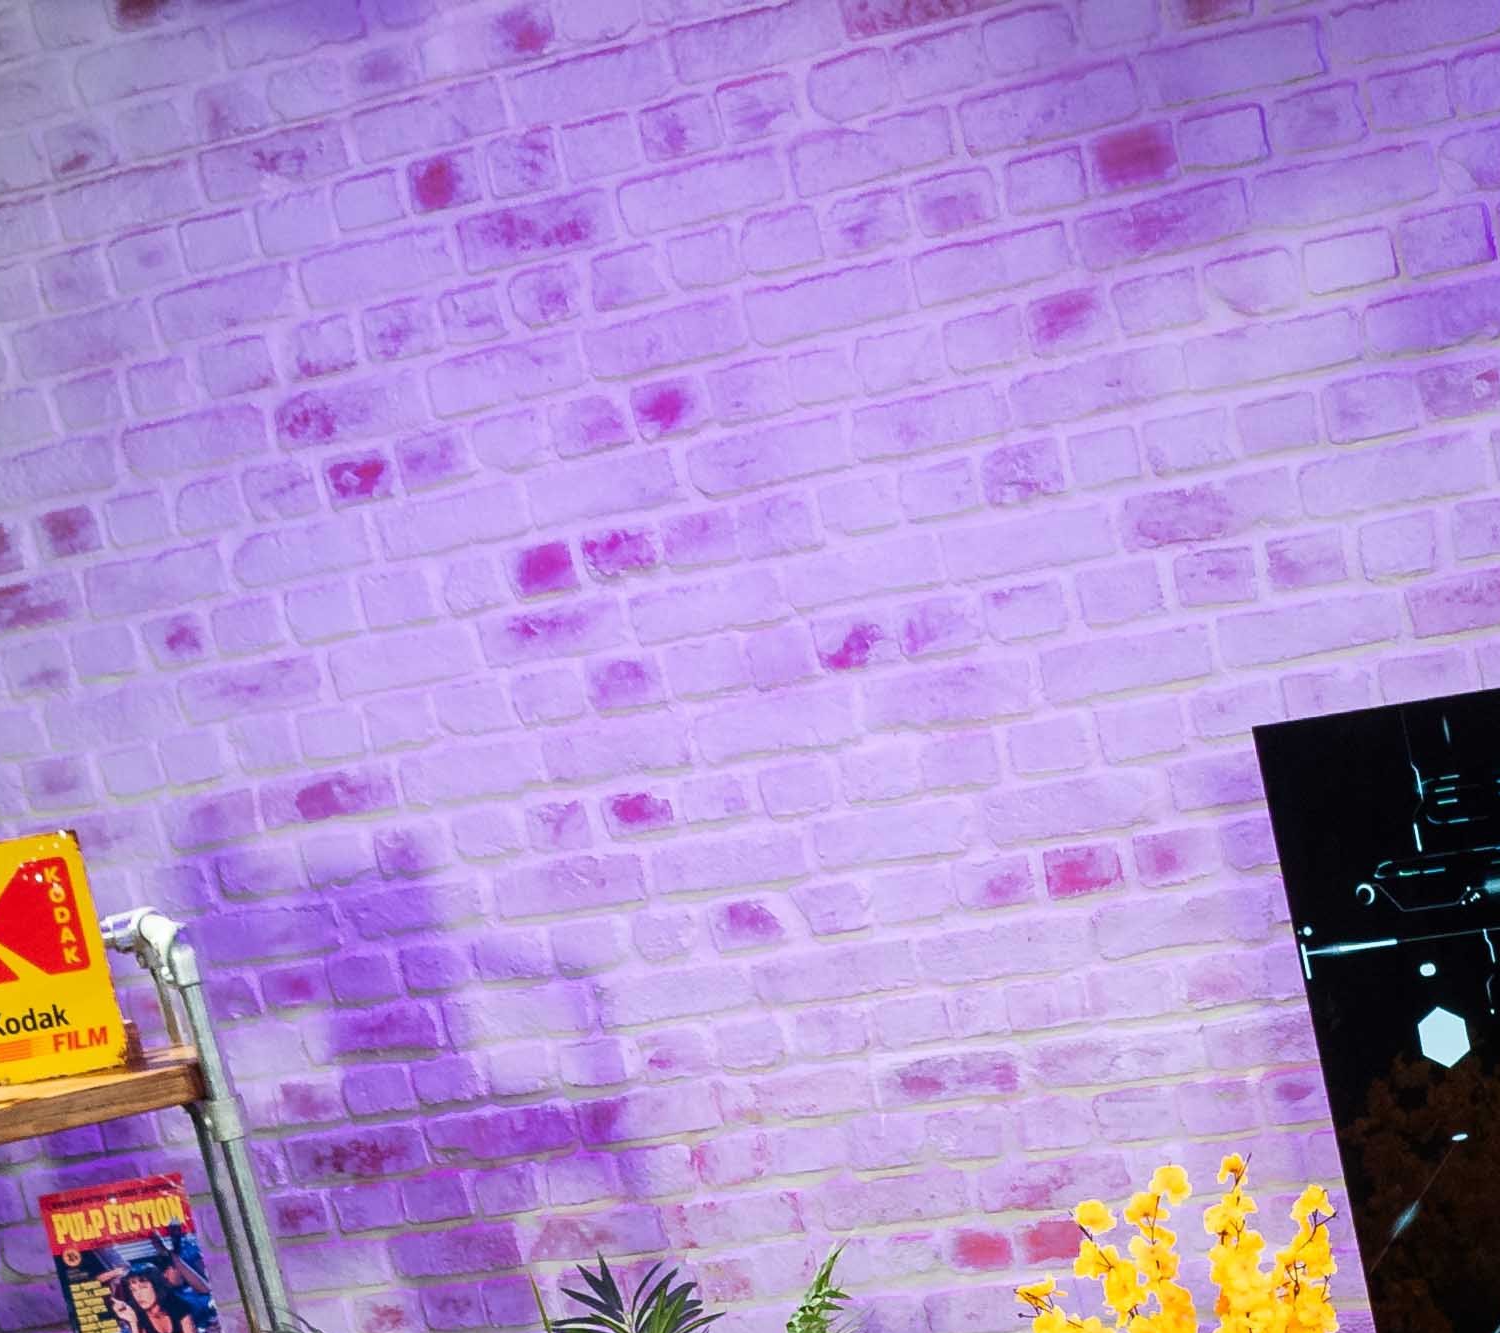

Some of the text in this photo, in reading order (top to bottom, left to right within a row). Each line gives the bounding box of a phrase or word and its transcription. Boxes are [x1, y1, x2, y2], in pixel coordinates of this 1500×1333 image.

[44, 865, 83, 965] KODAK
[52, 1025, 109, 1053] FILM
[51, 1195, 185, 1245] PULP FICTION
